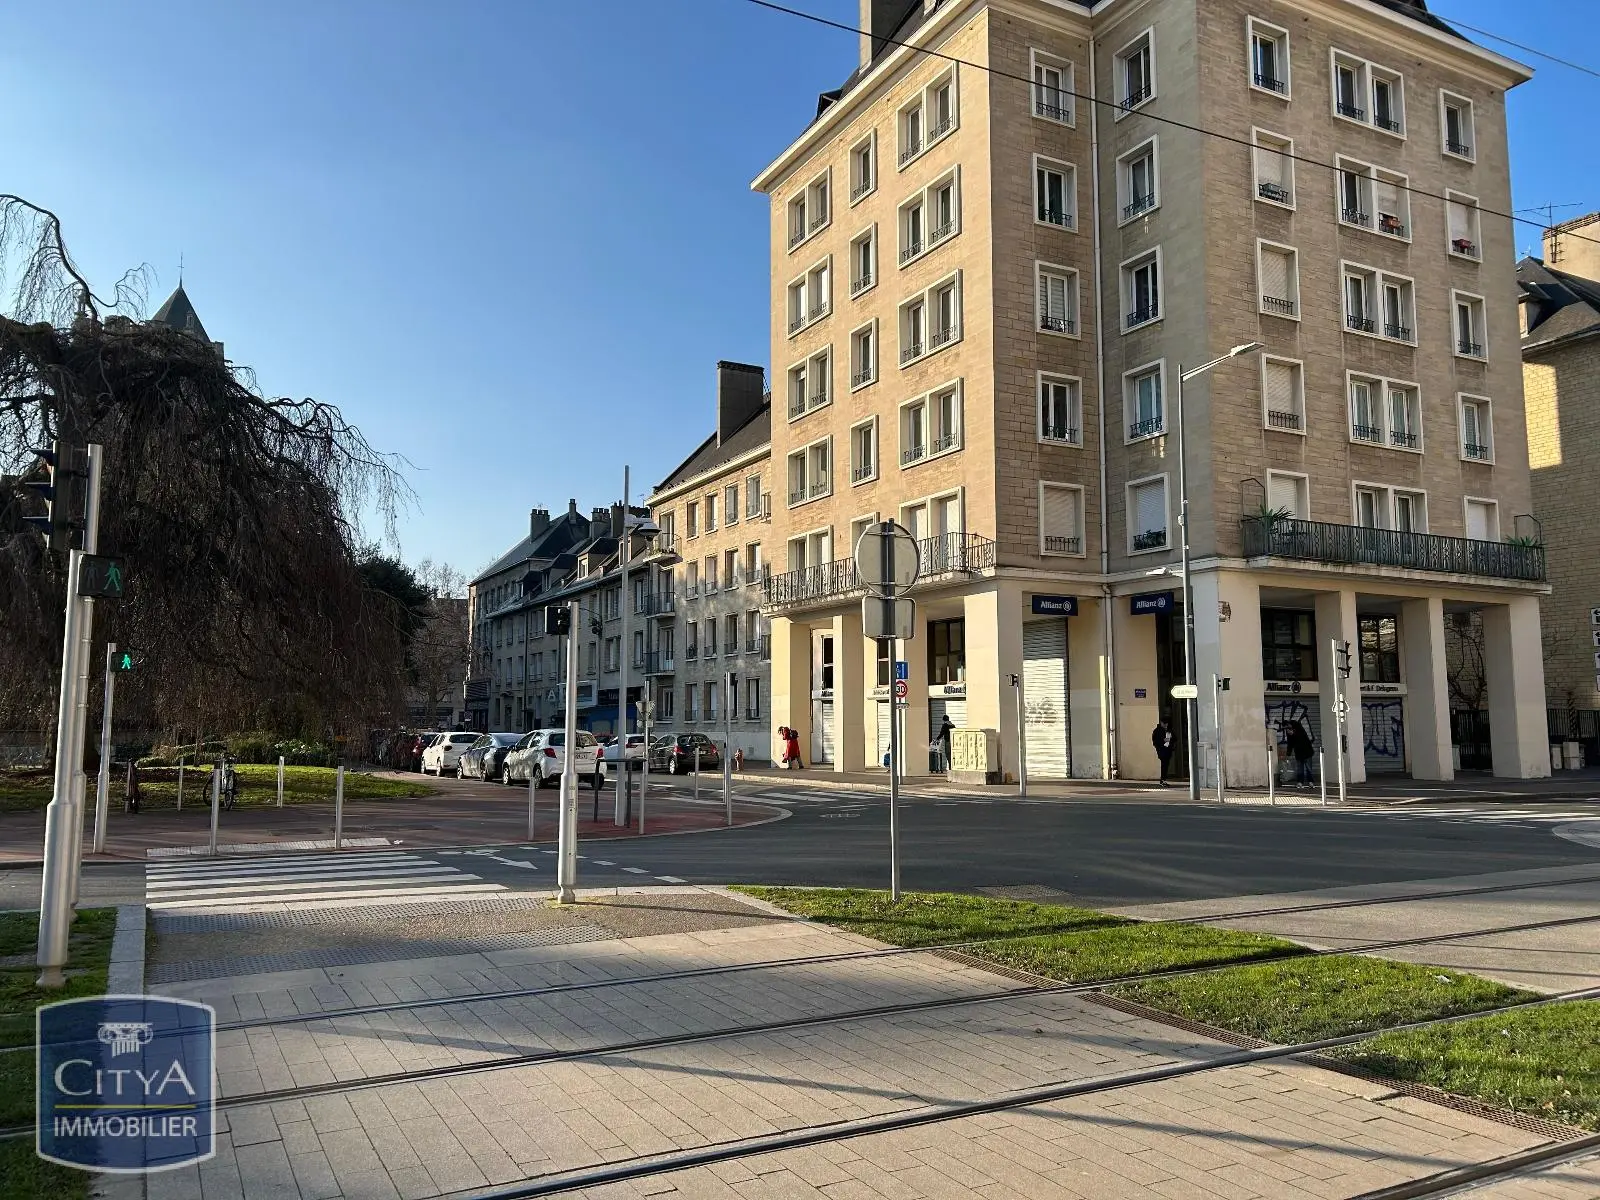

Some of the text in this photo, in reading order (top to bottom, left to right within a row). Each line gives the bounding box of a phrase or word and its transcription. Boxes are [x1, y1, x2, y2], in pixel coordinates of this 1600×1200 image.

[1040, 600, 1062, 609] Allianz
[1136, 600, 1157, 609] Allianz
[1266, 682, 1291, 691] Allianz
